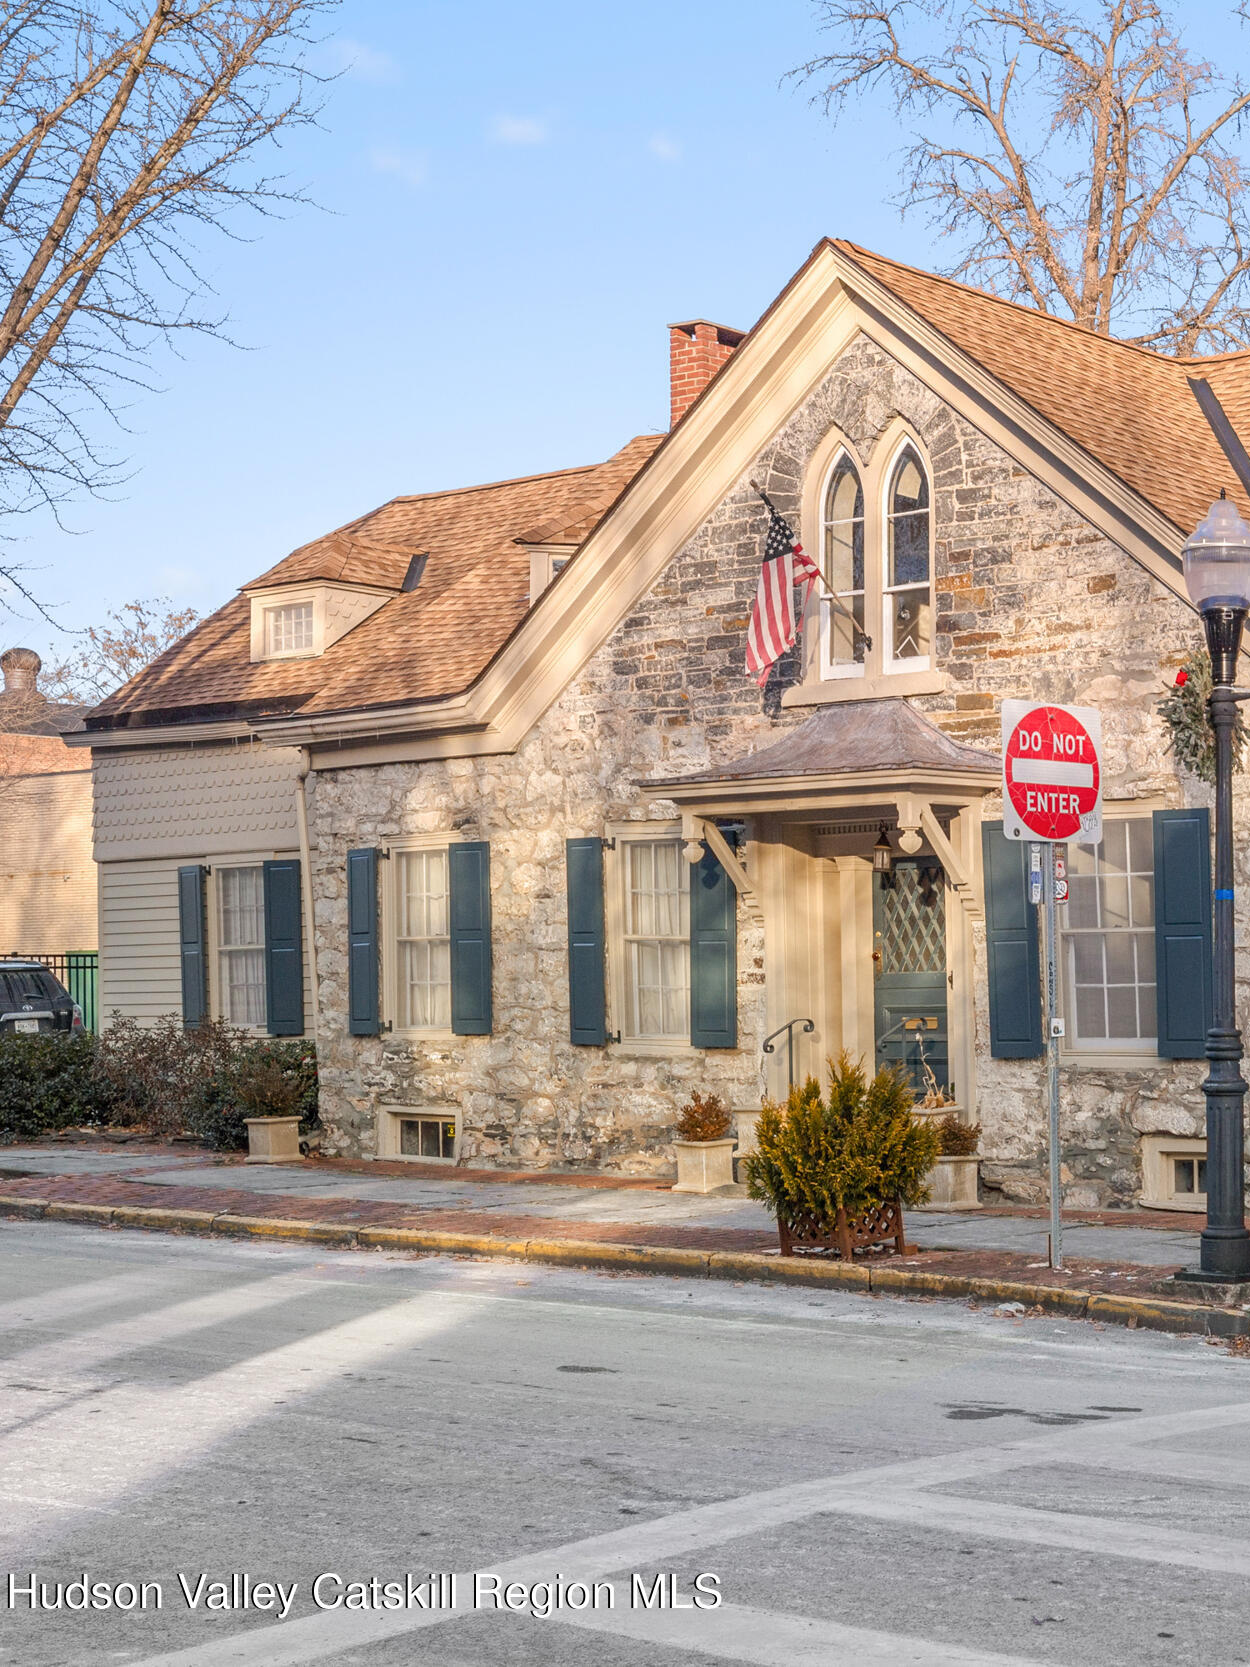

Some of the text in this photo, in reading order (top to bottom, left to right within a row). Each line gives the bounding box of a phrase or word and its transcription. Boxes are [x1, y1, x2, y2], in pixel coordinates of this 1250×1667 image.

[1019, 730, 1086, 756] DO NOT
[1027, 791, 1080, 814] ENTER
